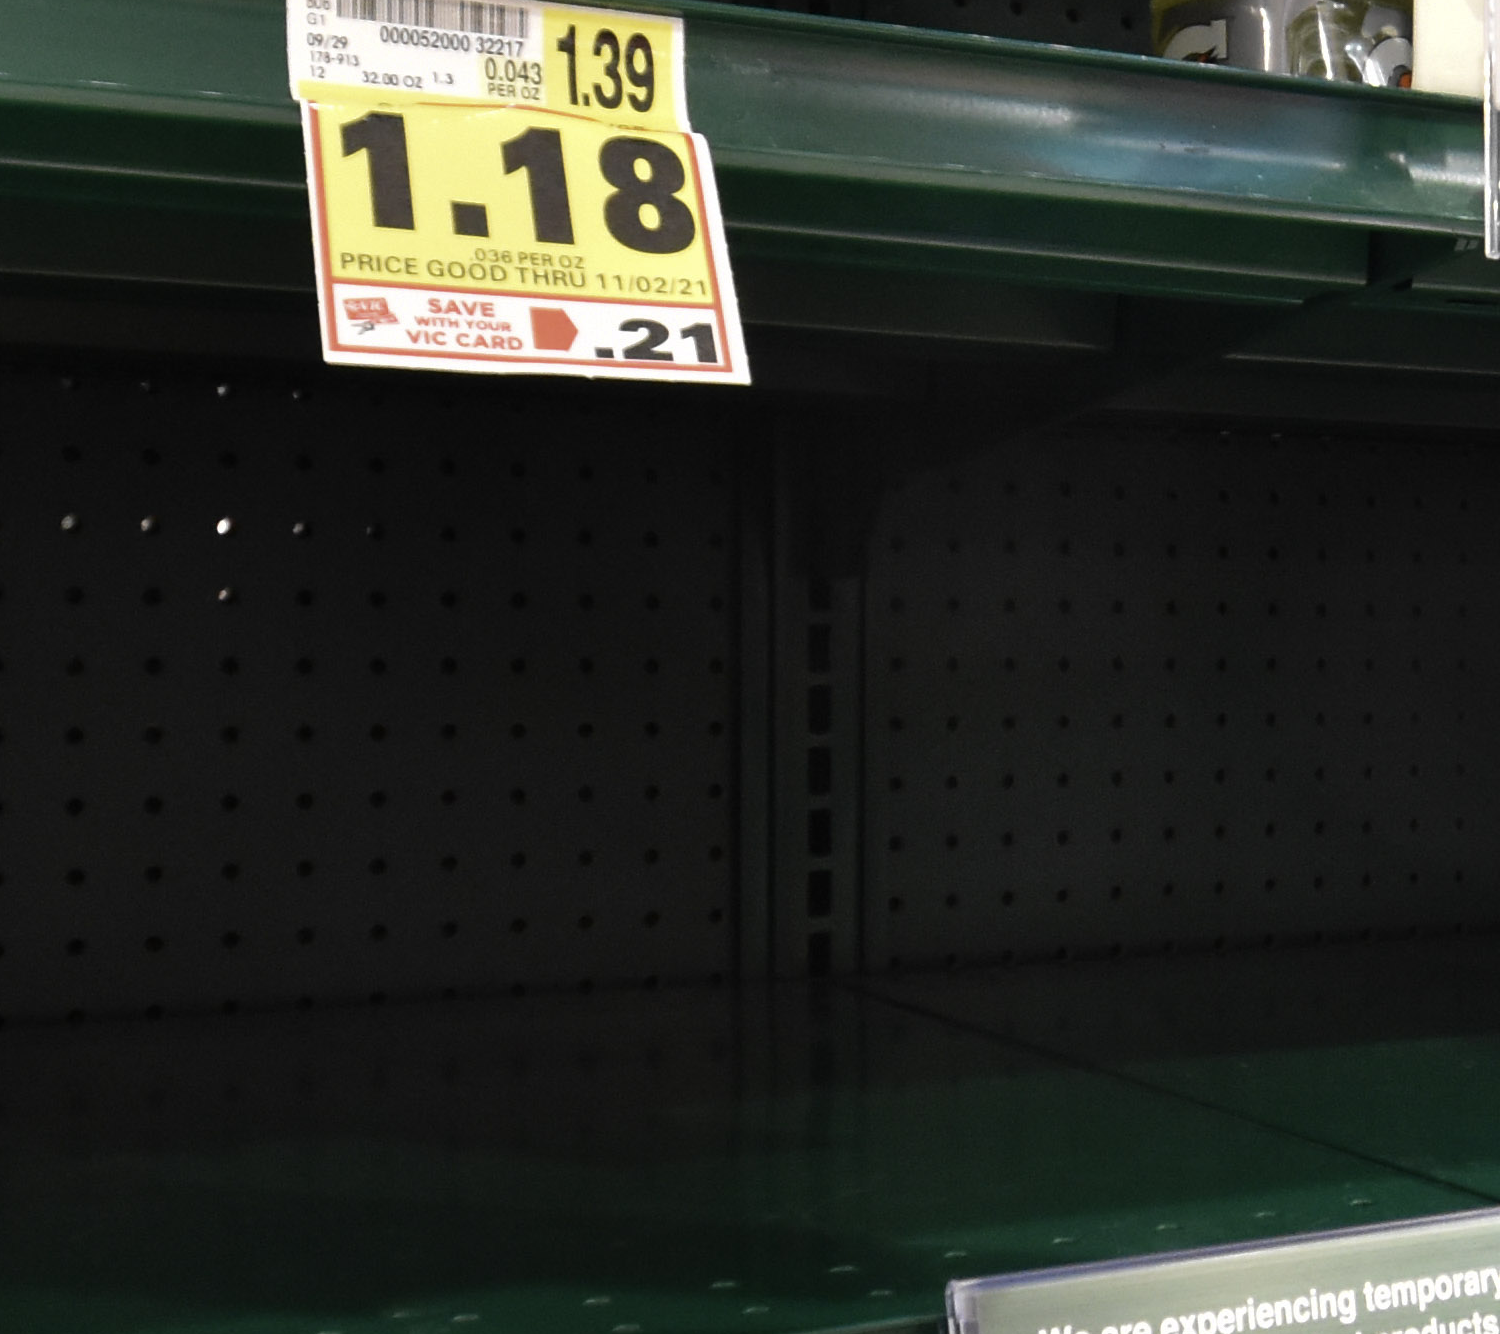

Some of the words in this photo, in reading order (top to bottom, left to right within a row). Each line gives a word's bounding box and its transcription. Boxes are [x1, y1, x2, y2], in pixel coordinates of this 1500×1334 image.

[307, 33, 347, 48] 09/29
[380, 26, 470, 52] 000052000
[476, 38, 523, 57] 32217
[310, 65, 324, 78] 12
[485, 57, 542, 85] 0.043
[557, 23, 655, 113] 1.39
[404, 75, 423, 88] OZ
[488, 83, 515, 98] PER
[521, 86, 540, 100] OZ
[340, 110, 696, 255] 1.18
[471, 247, 512, 265] .036
[518, 253, 552, 267] PER
[558, 254, 584, 269] OZ
[340, 253, 418, 276] PRICE
[427, 260, 508, 282] GOOD
[517, 267, 586, 288] THRU
[596, 272, 709, 296] 11/02/21
[428, 298, 495, 317] SAVE
[414, 316, 458, 328] WITH
[464, 320, 511, 332] YOUR
[405, 329, 447, 346] VIC
[455, 332, 523, 351] CARD
[594, 318, 719, 363] .21
